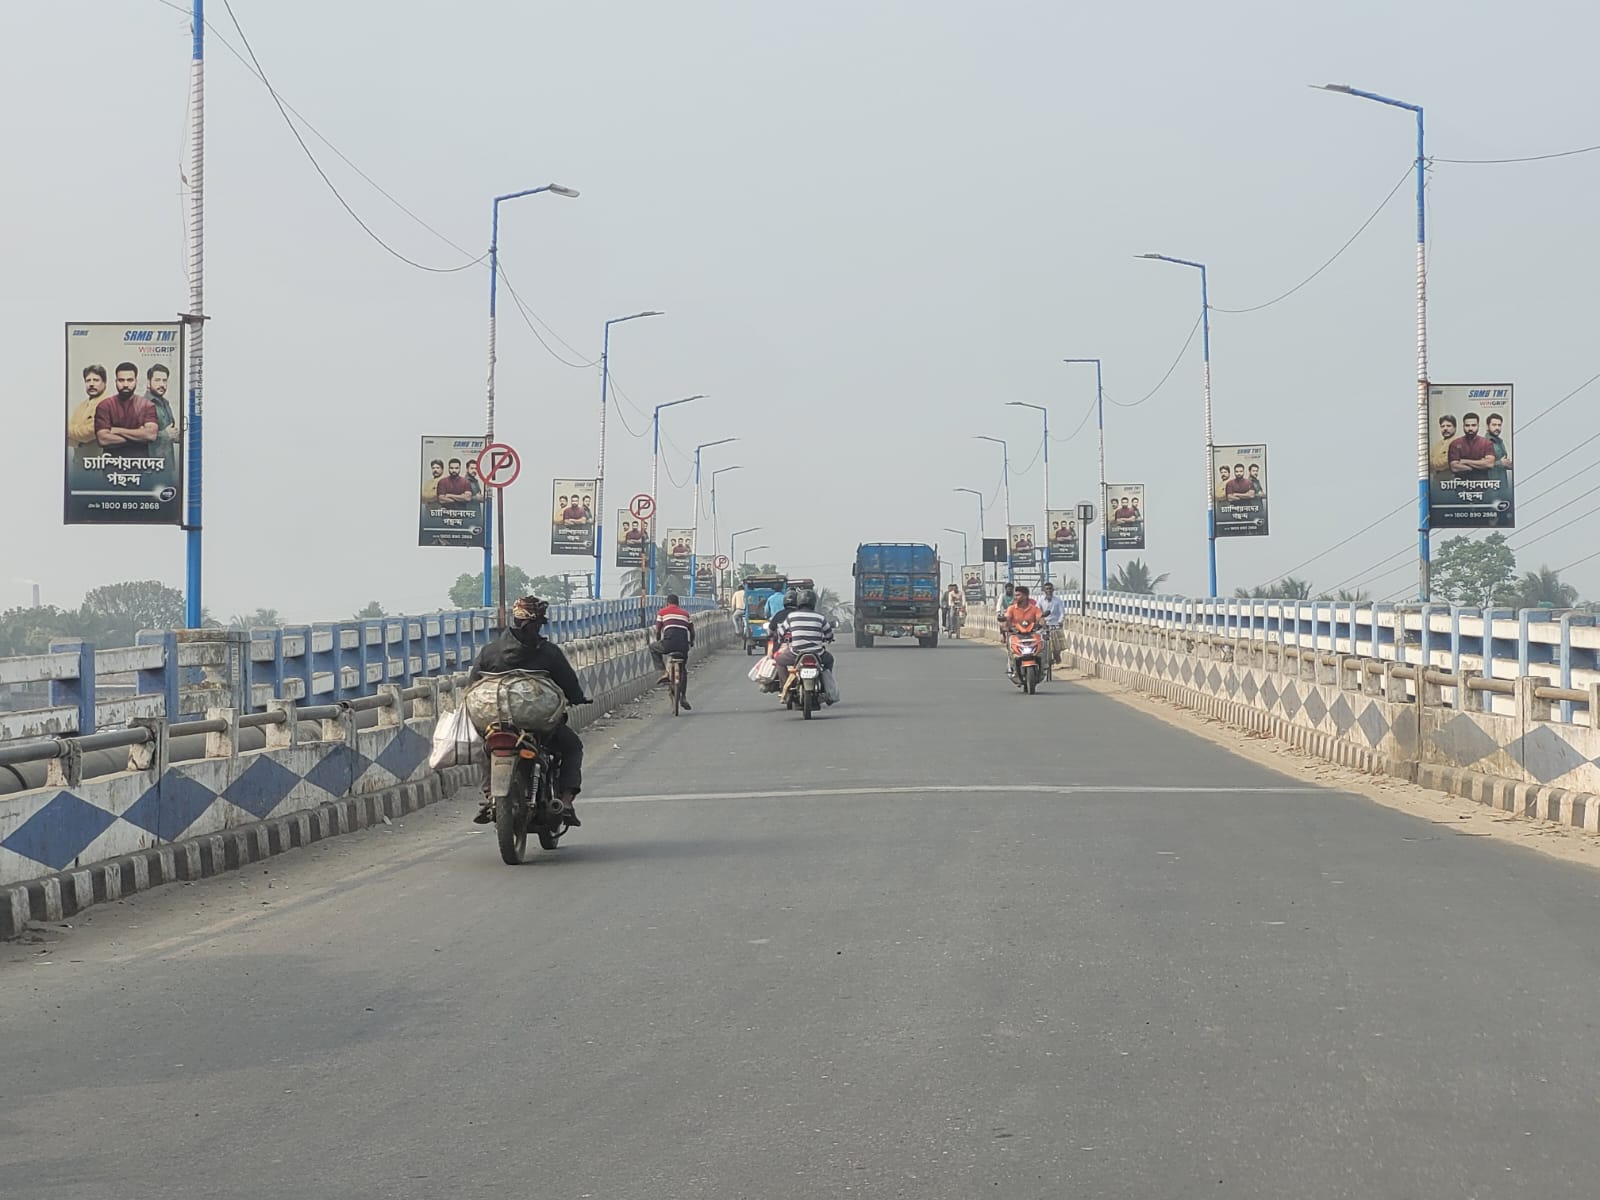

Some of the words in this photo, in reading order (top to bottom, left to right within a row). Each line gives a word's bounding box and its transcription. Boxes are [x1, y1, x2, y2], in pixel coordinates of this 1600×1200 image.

[123, 330, 154, 342] SRMB
[155, 330, 178, 342] TMT
[1492, 389, 1508, 398] TMT
[82, 452, 166, 471] চ্যাম্পিয়নদের
[491, 451, 514, 481] P
[106, 471, 142, 487] পছন্দ
[101, 502, 121, 510] 1800
[122, 502, 138, 510] 890
[140, 502, 160, 510] 2868
[637, 498, 651, 516] P
